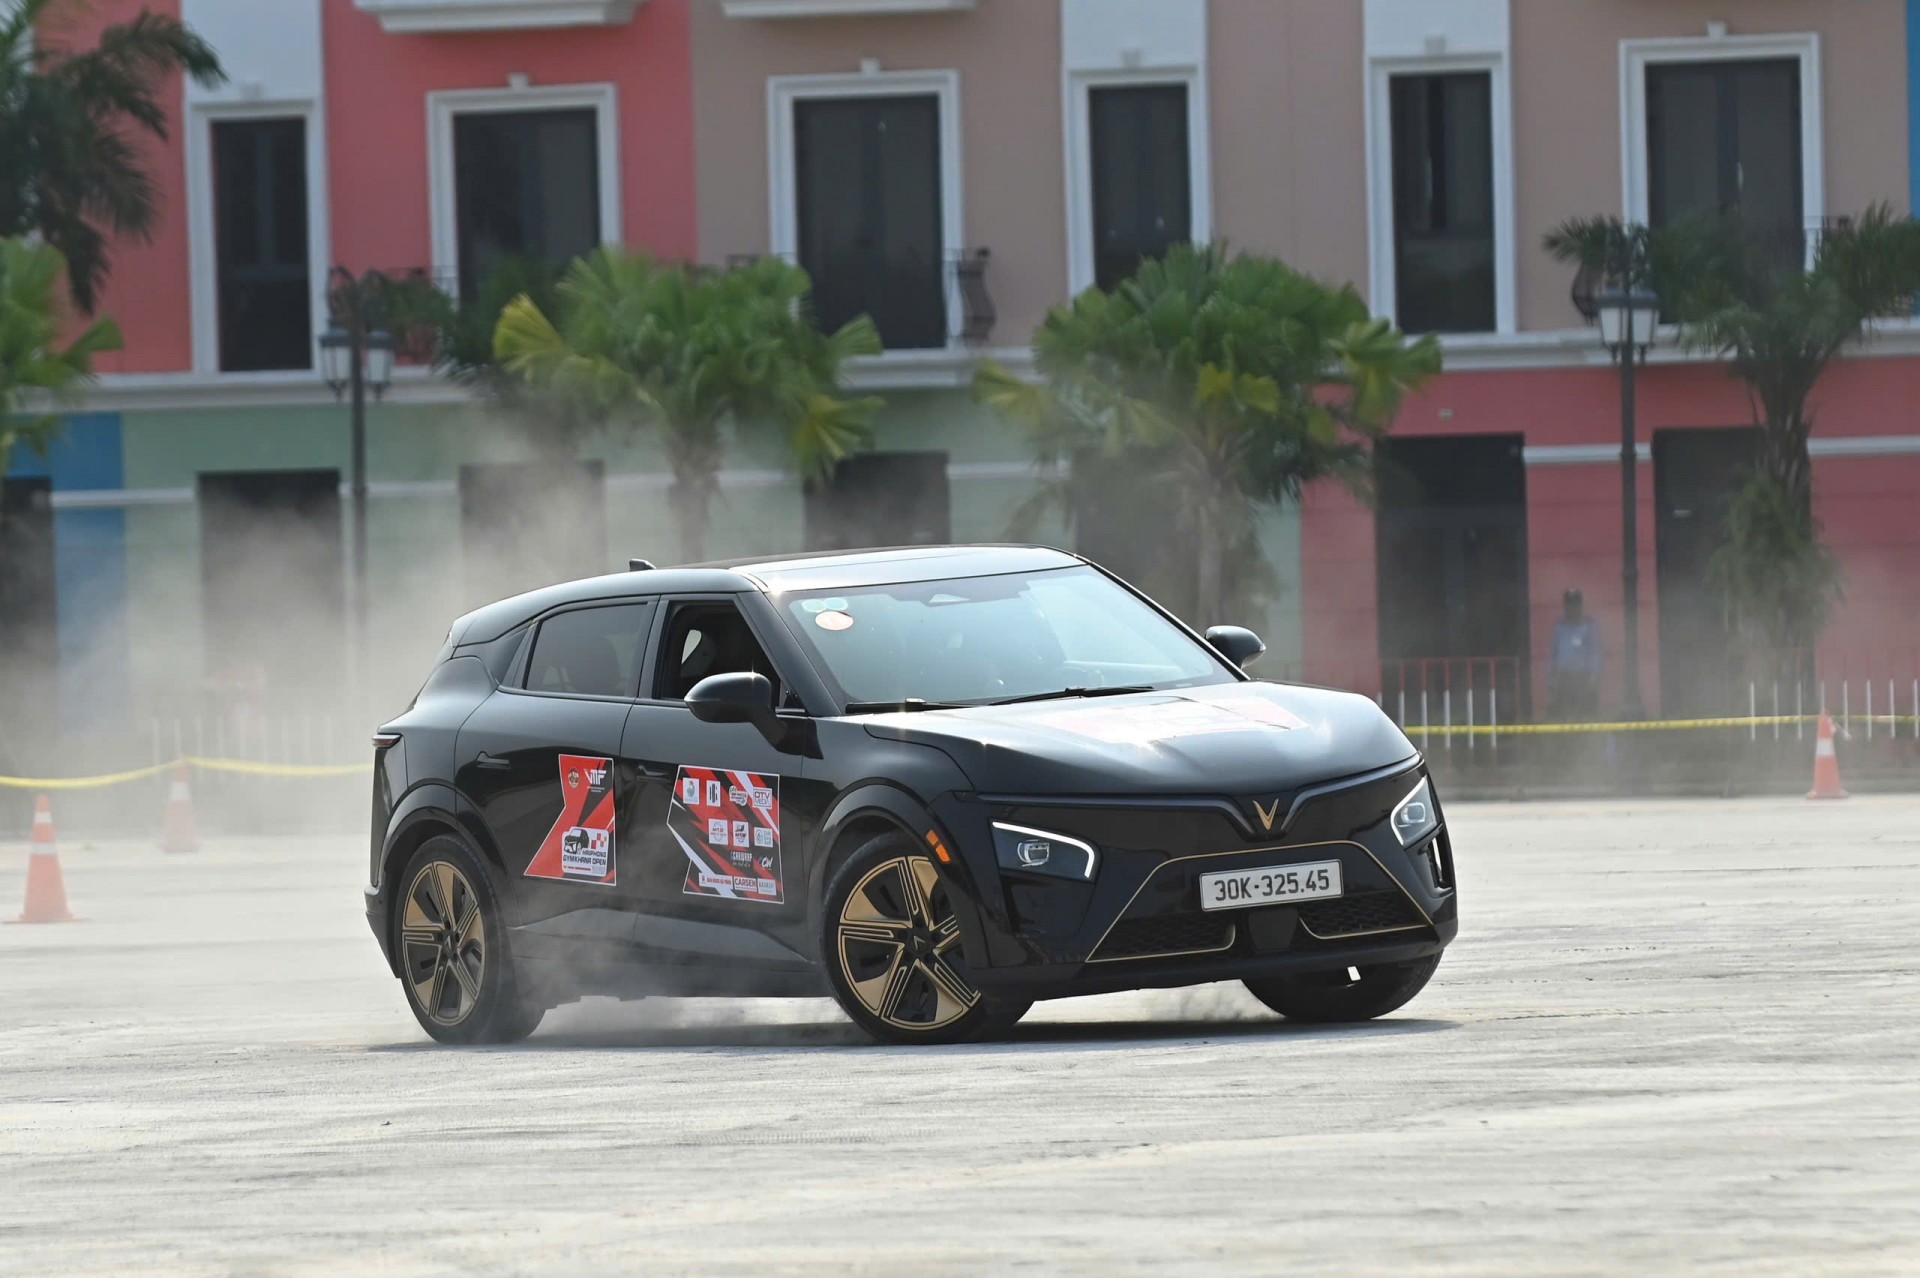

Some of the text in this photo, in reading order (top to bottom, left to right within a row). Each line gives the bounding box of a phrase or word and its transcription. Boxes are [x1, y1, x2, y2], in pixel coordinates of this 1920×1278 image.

[563, 854, 607, 866] GYMKHANA OPEN
[734, 876, 757, 887] CARSEN
[1214, 869, 1330, 901] 30K-325.45
